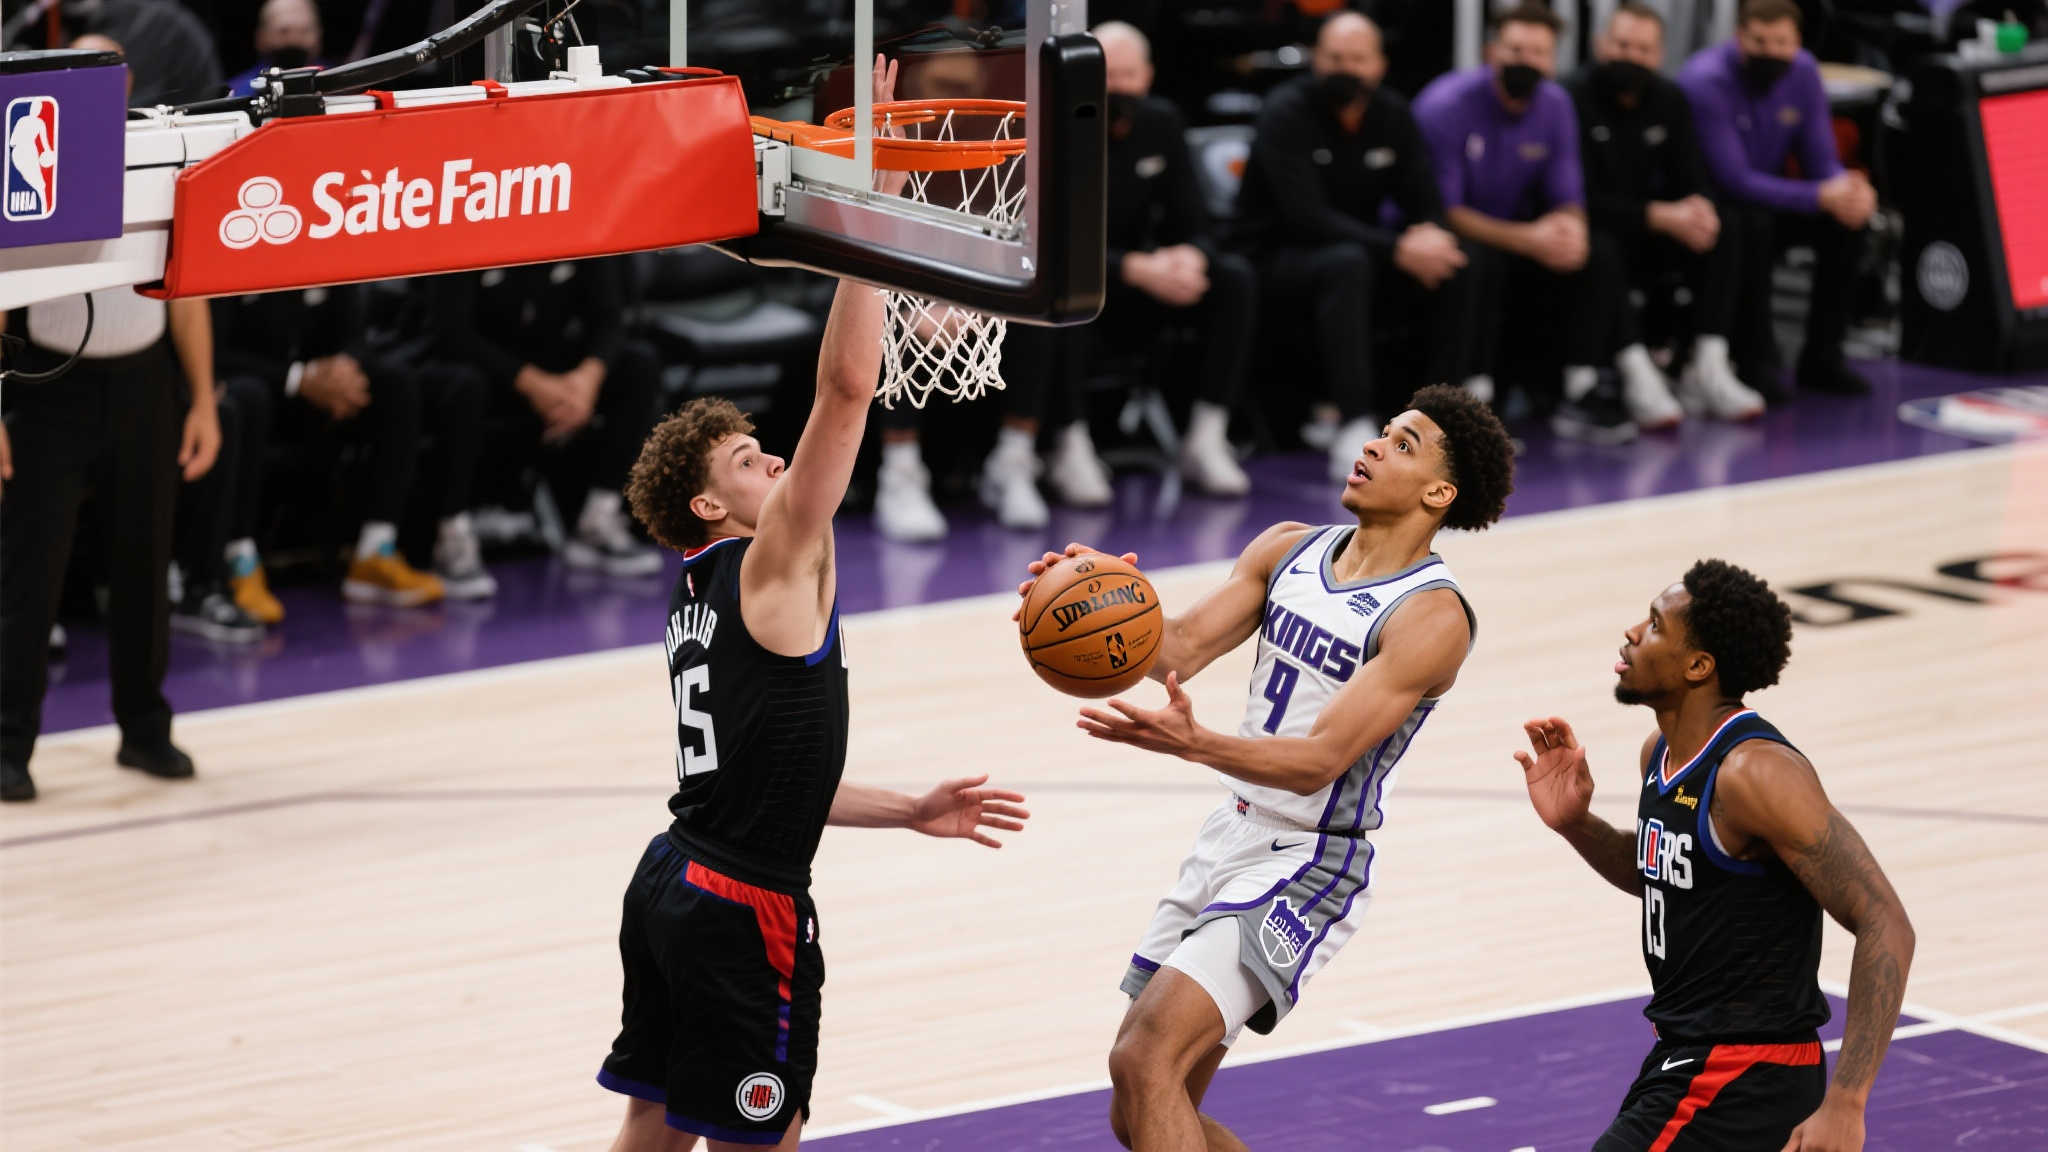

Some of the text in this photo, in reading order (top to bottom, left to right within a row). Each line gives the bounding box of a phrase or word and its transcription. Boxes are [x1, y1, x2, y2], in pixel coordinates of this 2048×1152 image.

[438, 158, 572, 225] Farm
[1262, 600, 1362, 683] KINGS
[1263, 657, 1300, 735] 9
